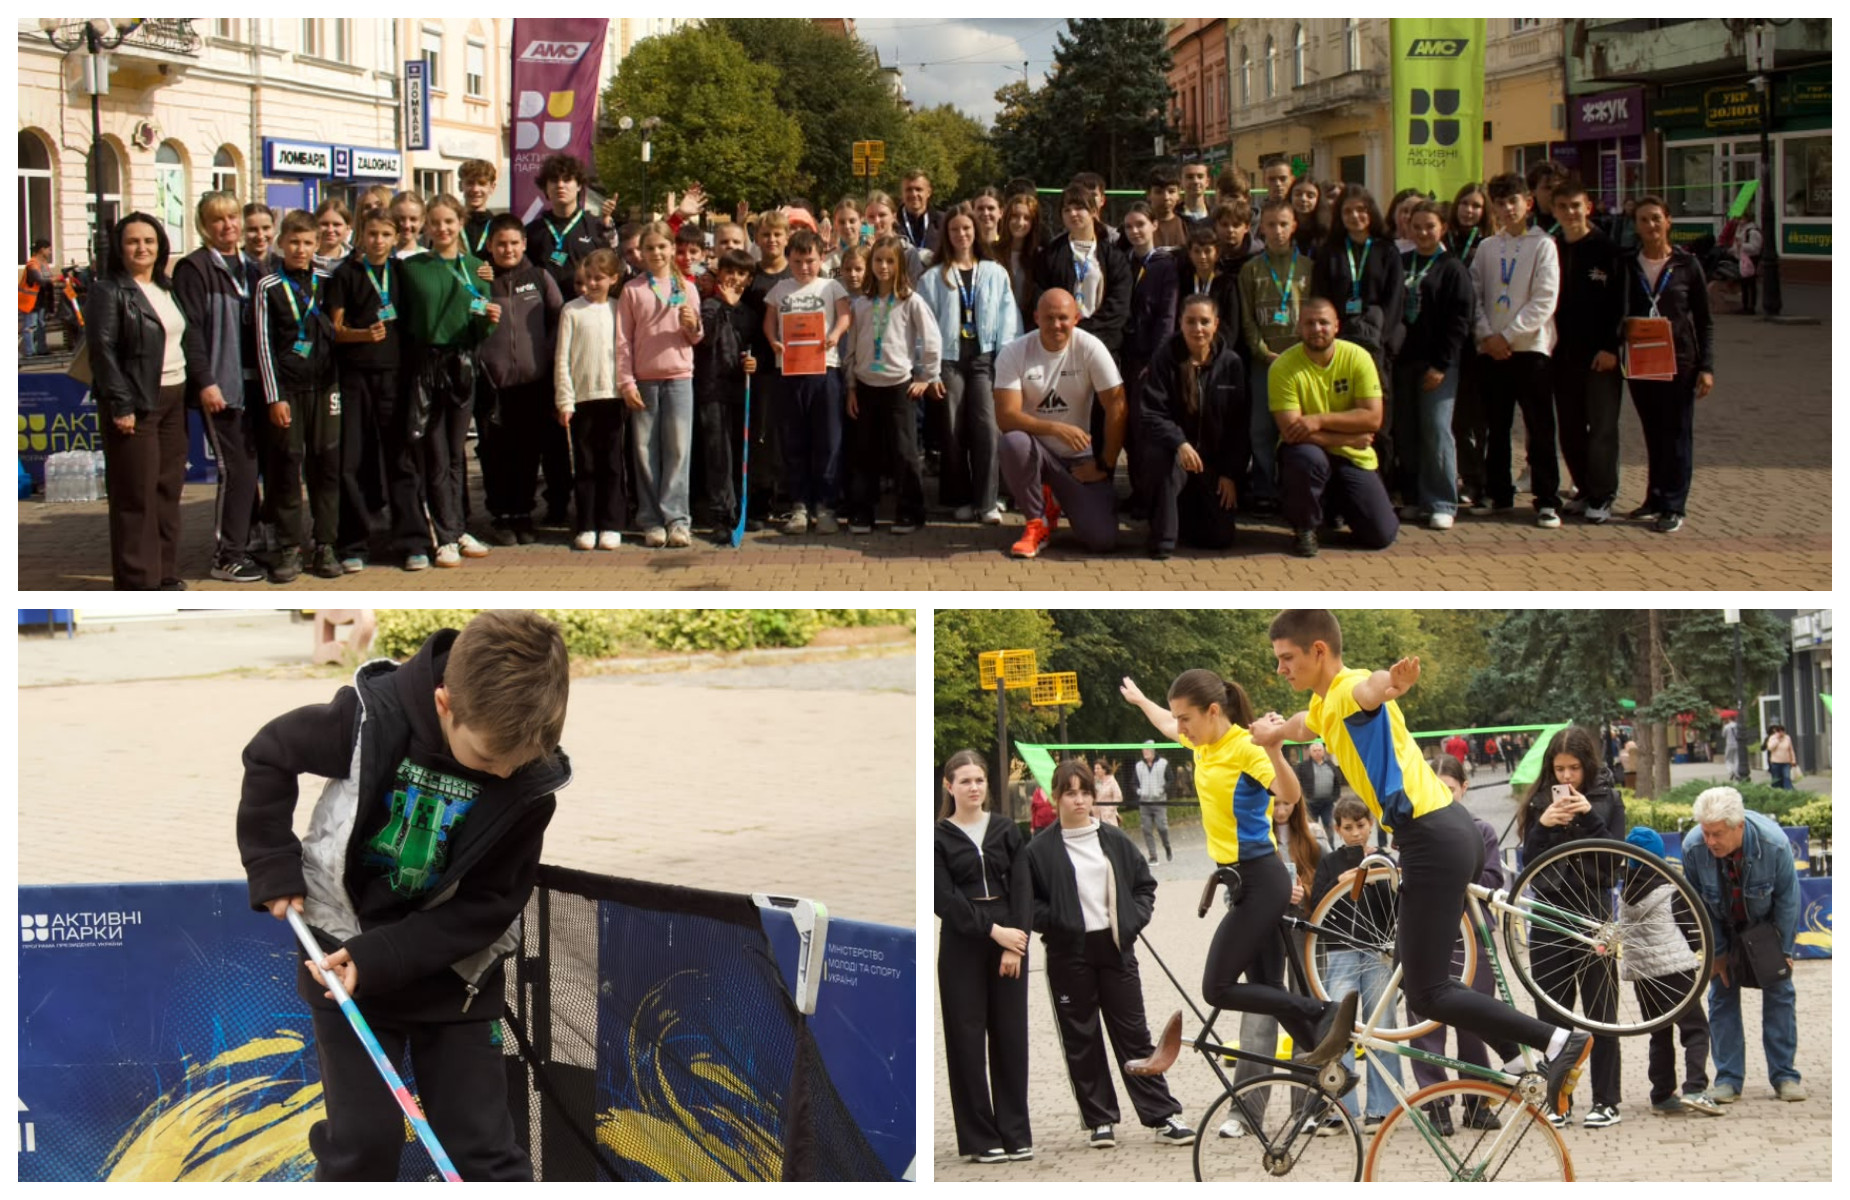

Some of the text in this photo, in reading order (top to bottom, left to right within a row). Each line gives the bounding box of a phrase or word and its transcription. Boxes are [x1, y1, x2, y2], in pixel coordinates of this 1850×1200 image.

[411, 81, 420, 143] ЛОМБАРД
[279, 150, 326, 169] ЛОМБАРД
[1408, 148, 1458, 159] АКТИВНІ
[357, 156, 397, 172] ZALOGHÁZ
[1407, 158, 1446, 168] ПАРКИ
[52, 911, 141, 927] АКТИВНІ
[51, 926, 123, 941] ПАРКИ
[828, 943, 885, 961] МІНІСТЕРСТВО
[828, 958, 901, 980] МОЛОДІ ТА СПОРТУ
[828, 973, 858, 987] УКРАЇНИ
